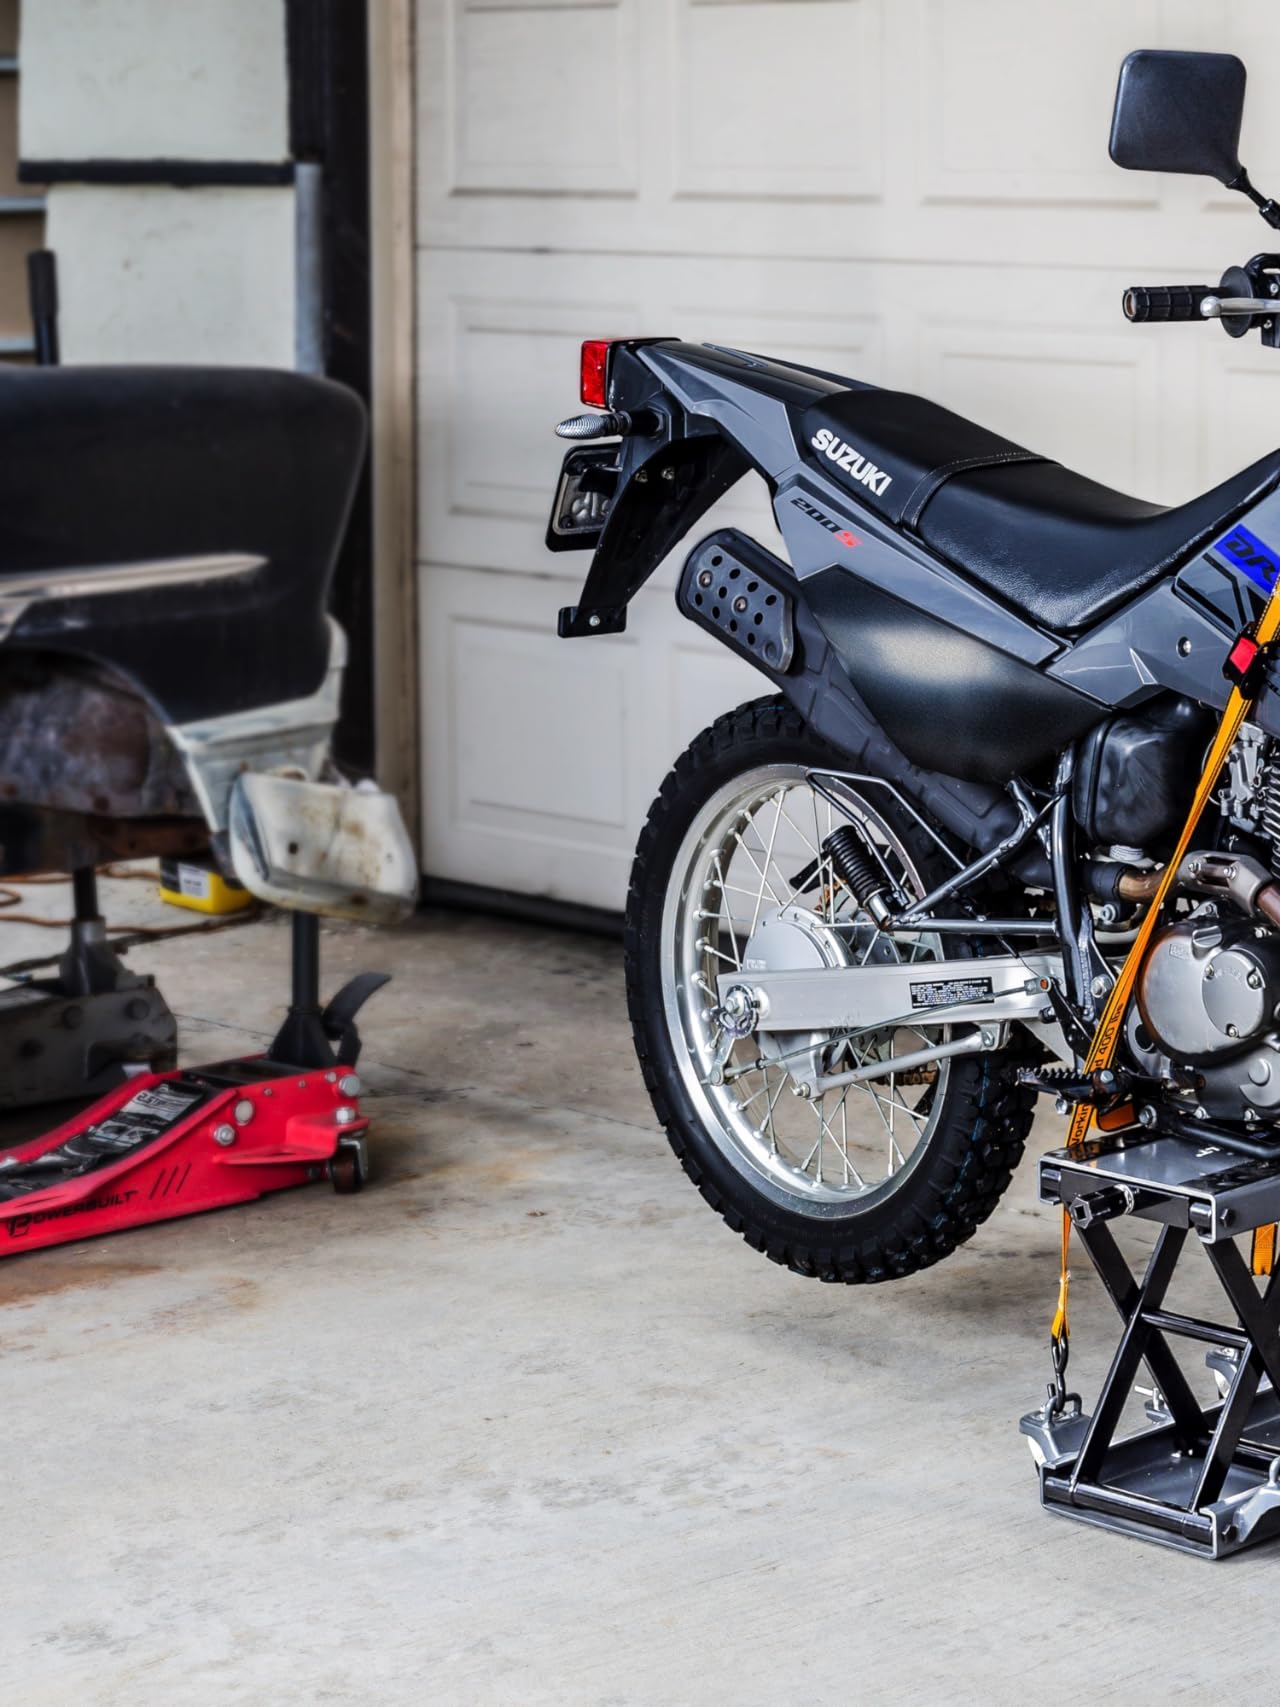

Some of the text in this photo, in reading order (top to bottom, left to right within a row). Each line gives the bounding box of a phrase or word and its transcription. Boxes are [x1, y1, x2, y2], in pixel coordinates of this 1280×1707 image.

[811, 429, 892, 496] SUZUKI
[790, 498, 863, 548] 200S
[1100, 1027, 1115, 1055] 400
[1111, 1003, 1124, 1023] lbs
